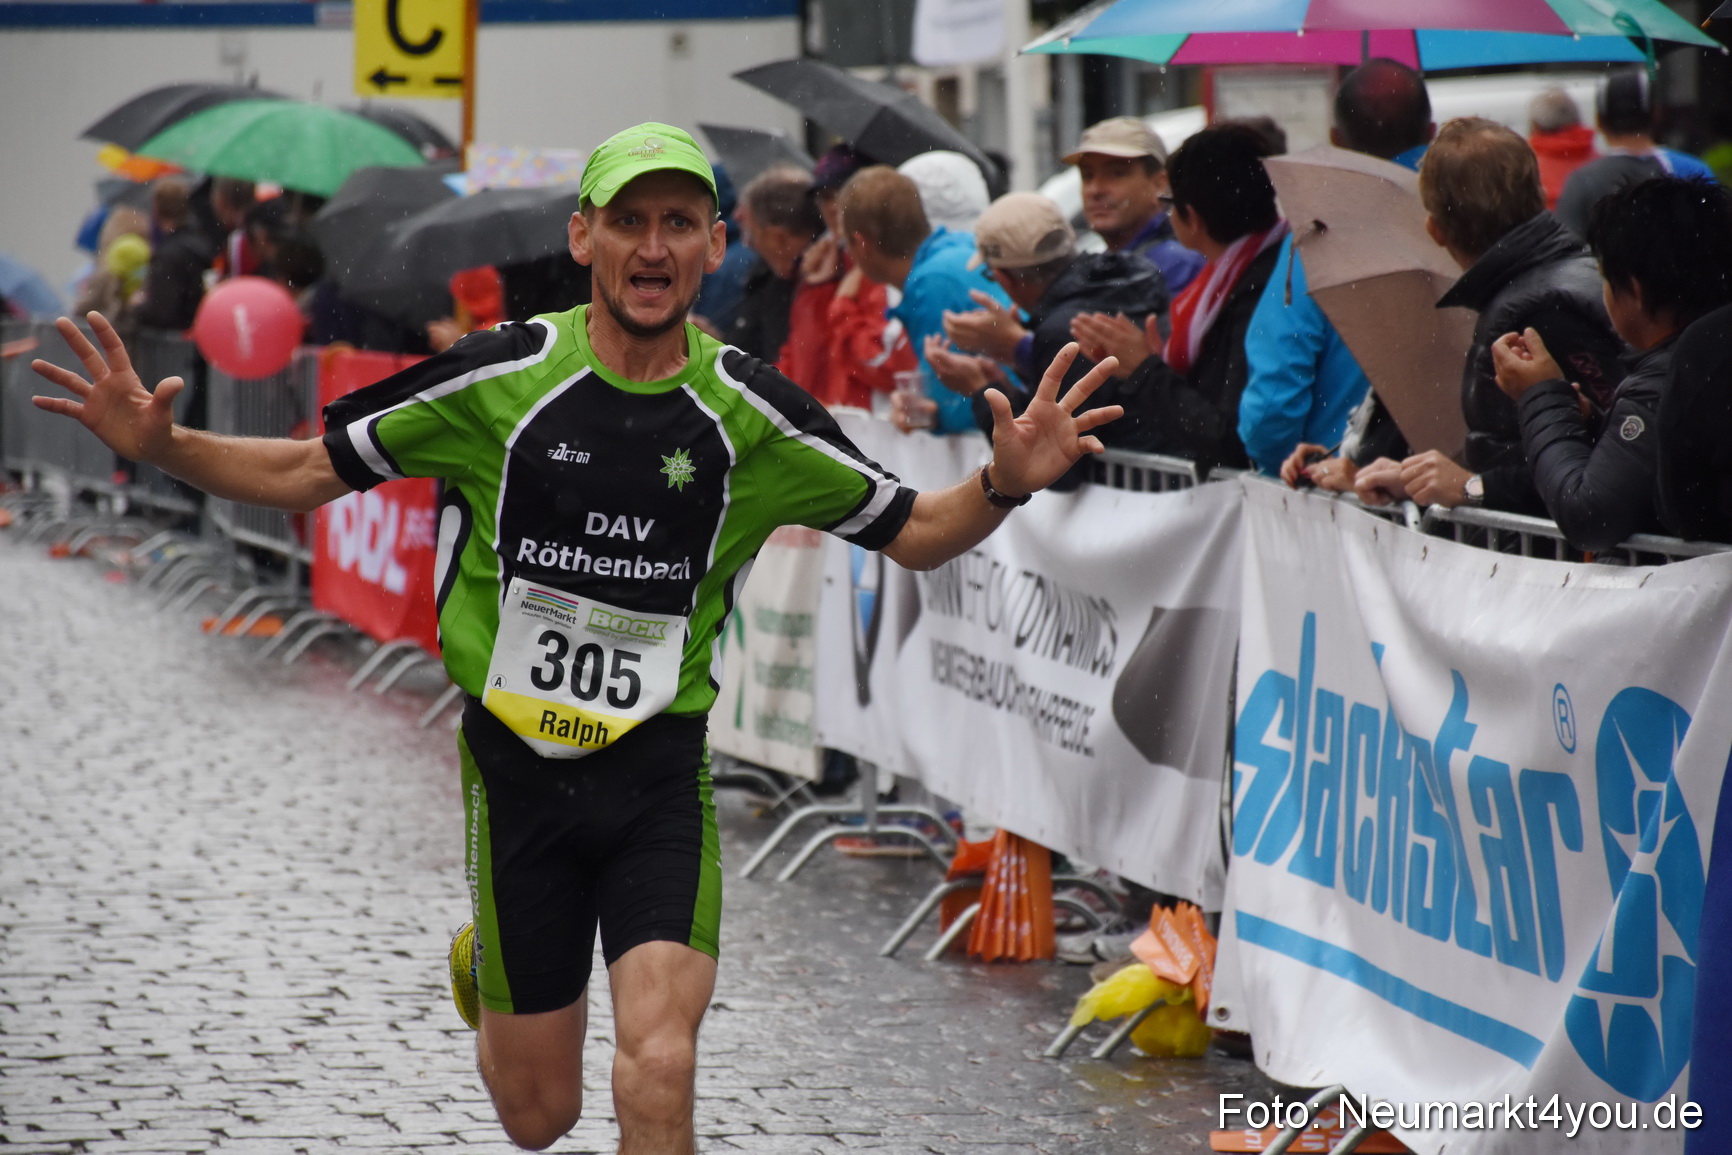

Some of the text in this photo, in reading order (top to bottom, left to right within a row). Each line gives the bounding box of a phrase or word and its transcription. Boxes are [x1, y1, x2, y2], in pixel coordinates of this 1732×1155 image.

[585, 511, 656, 542] DAV
[516, 537, 691, 580] Röthenbach
[520, 600, 577, 625] NeuerMarkt
[587, 608, 670, 641] BOCK
[493, 676, 503, 688] A
[531, 629, 642, 709] 305
[539, 710, 609, 746] Ralph
[1233, 610, 1584, 984] slackstar
